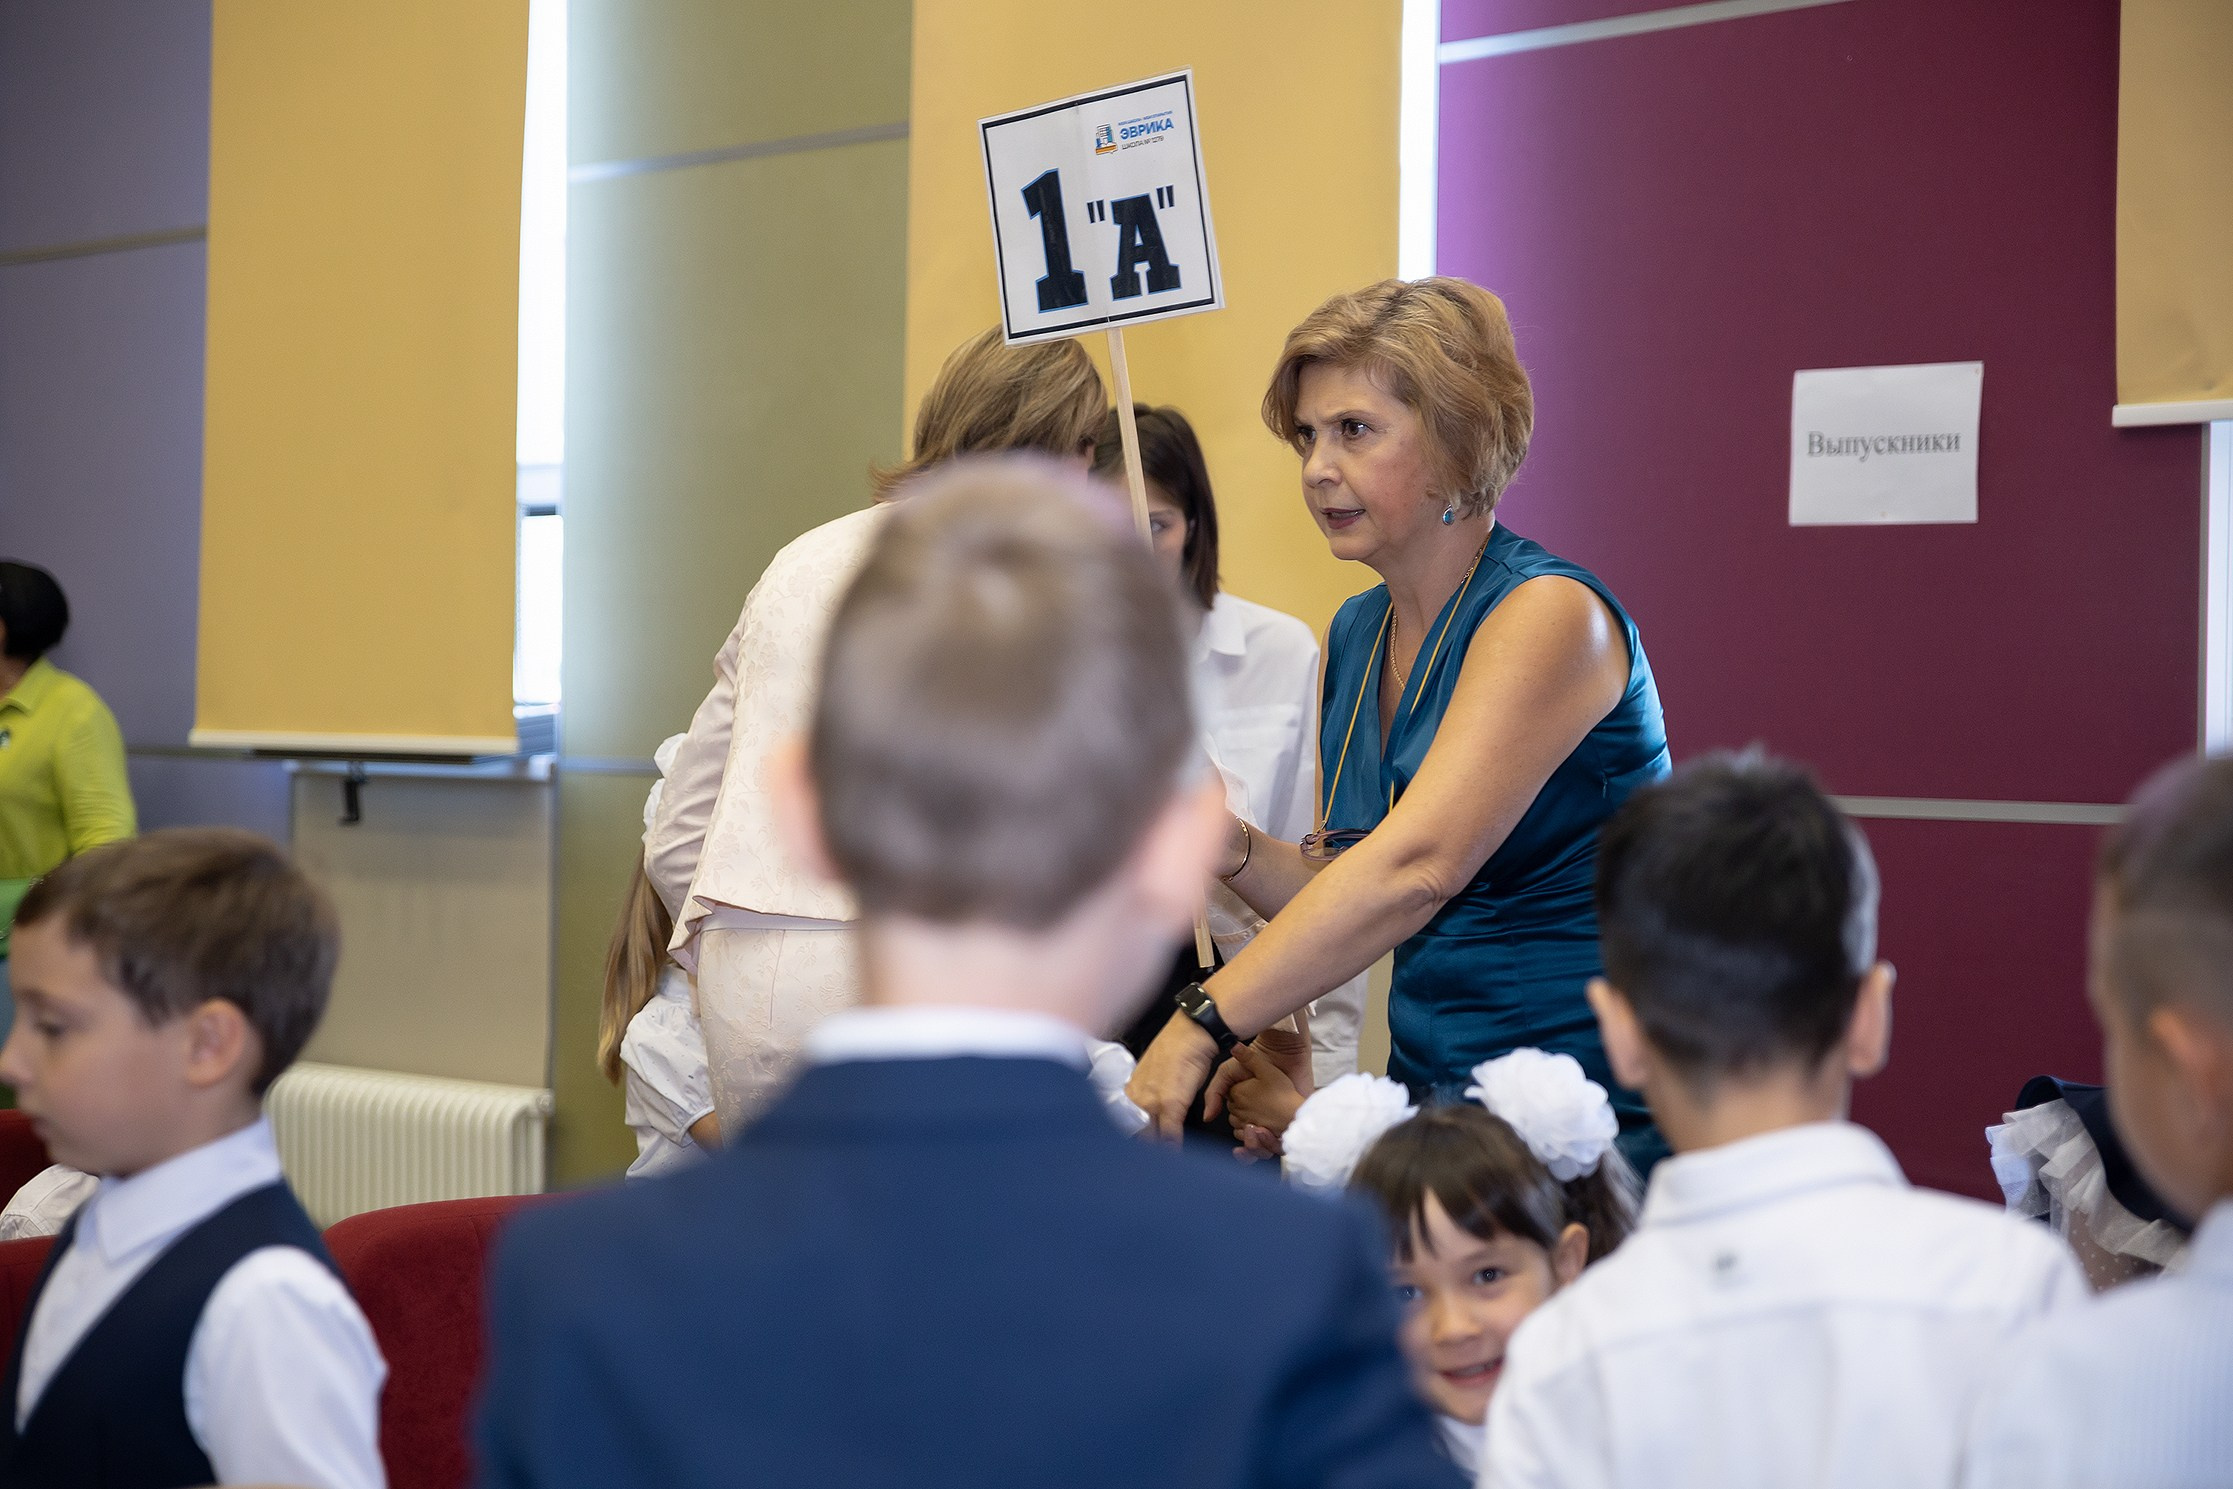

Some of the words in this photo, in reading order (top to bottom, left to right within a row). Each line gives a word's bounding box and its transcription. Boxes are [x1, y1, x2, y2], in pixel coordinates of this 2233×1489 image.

[1119, 117, 1174, 140] ЭВРИКА
[1121, 140, 1144, 150] ШКОЛА
[1021, 168, 1088, 312] 1
[1807, 431, 1962, 462] Выпускники
